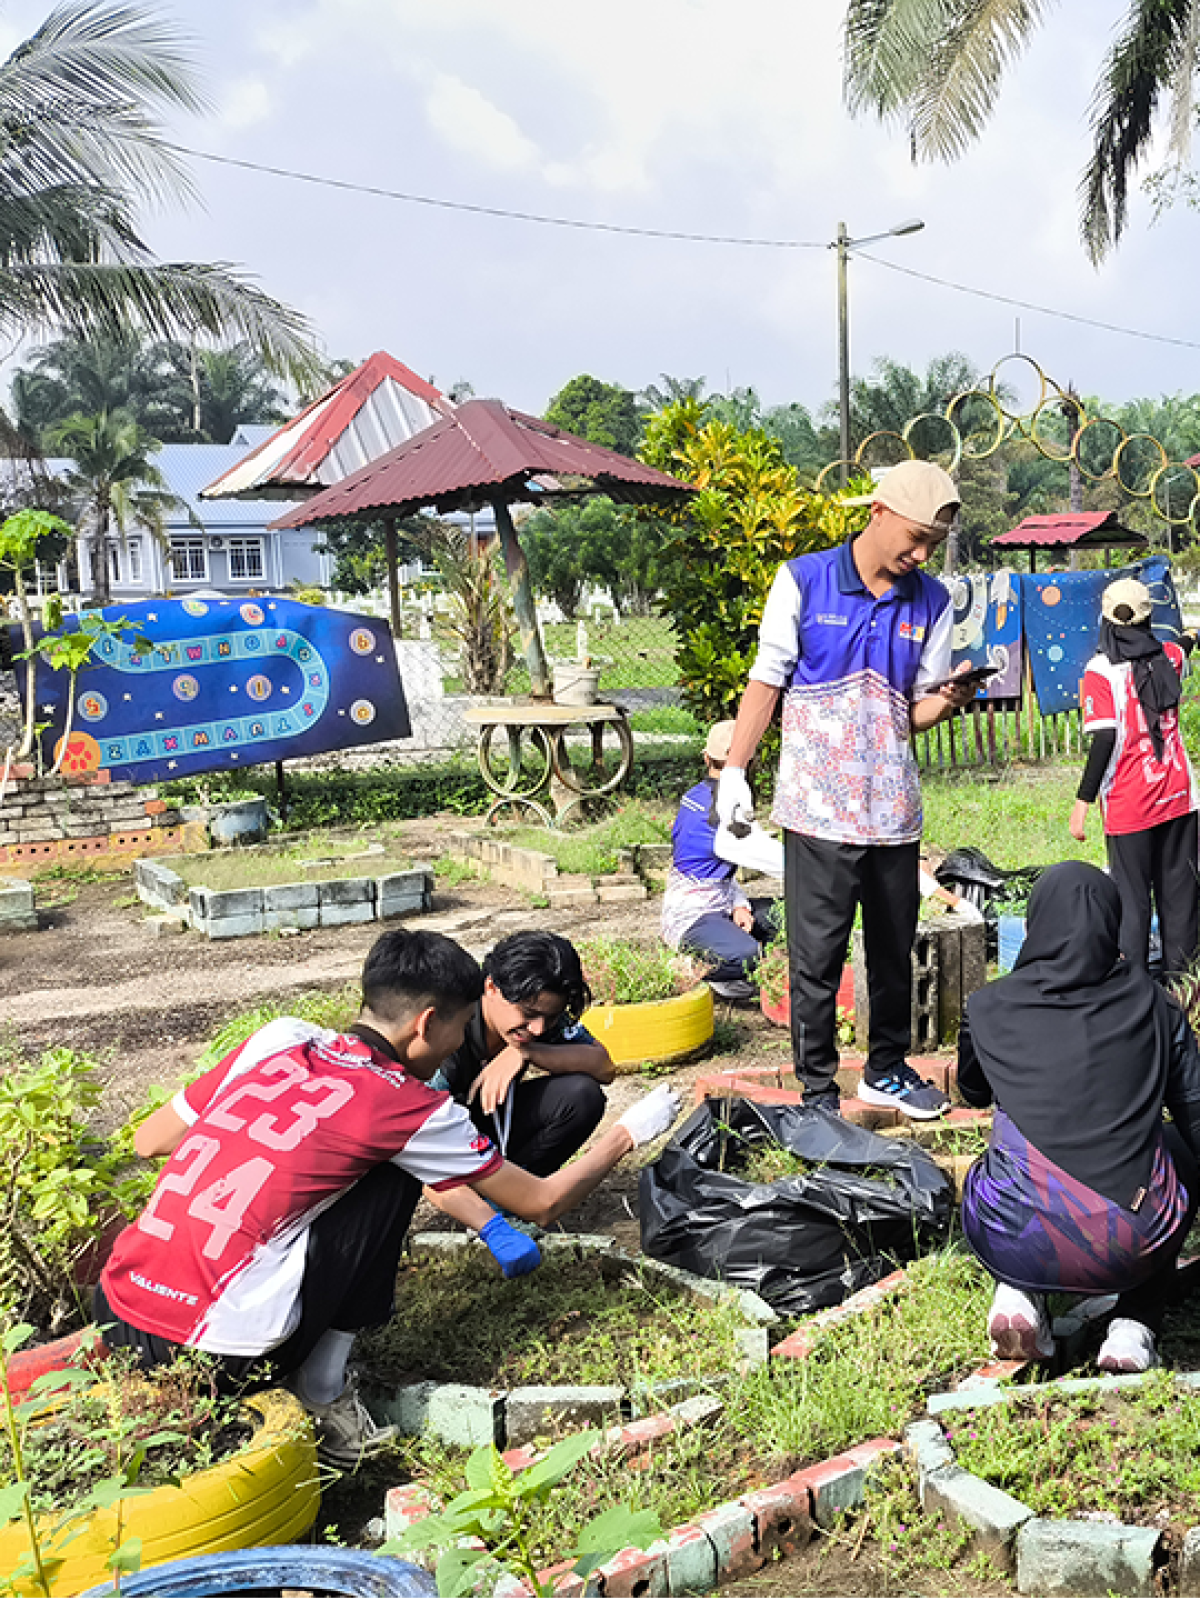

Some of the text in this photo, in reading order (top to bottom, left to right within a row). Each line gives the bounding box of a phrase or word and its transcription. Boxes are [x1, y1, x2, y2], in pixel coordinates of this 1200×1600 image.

[204, 1054, 355, 1151] 23
[138, 1135, 276, 1261] 24
[128, 1270, 199, 1306] VALIENTE
